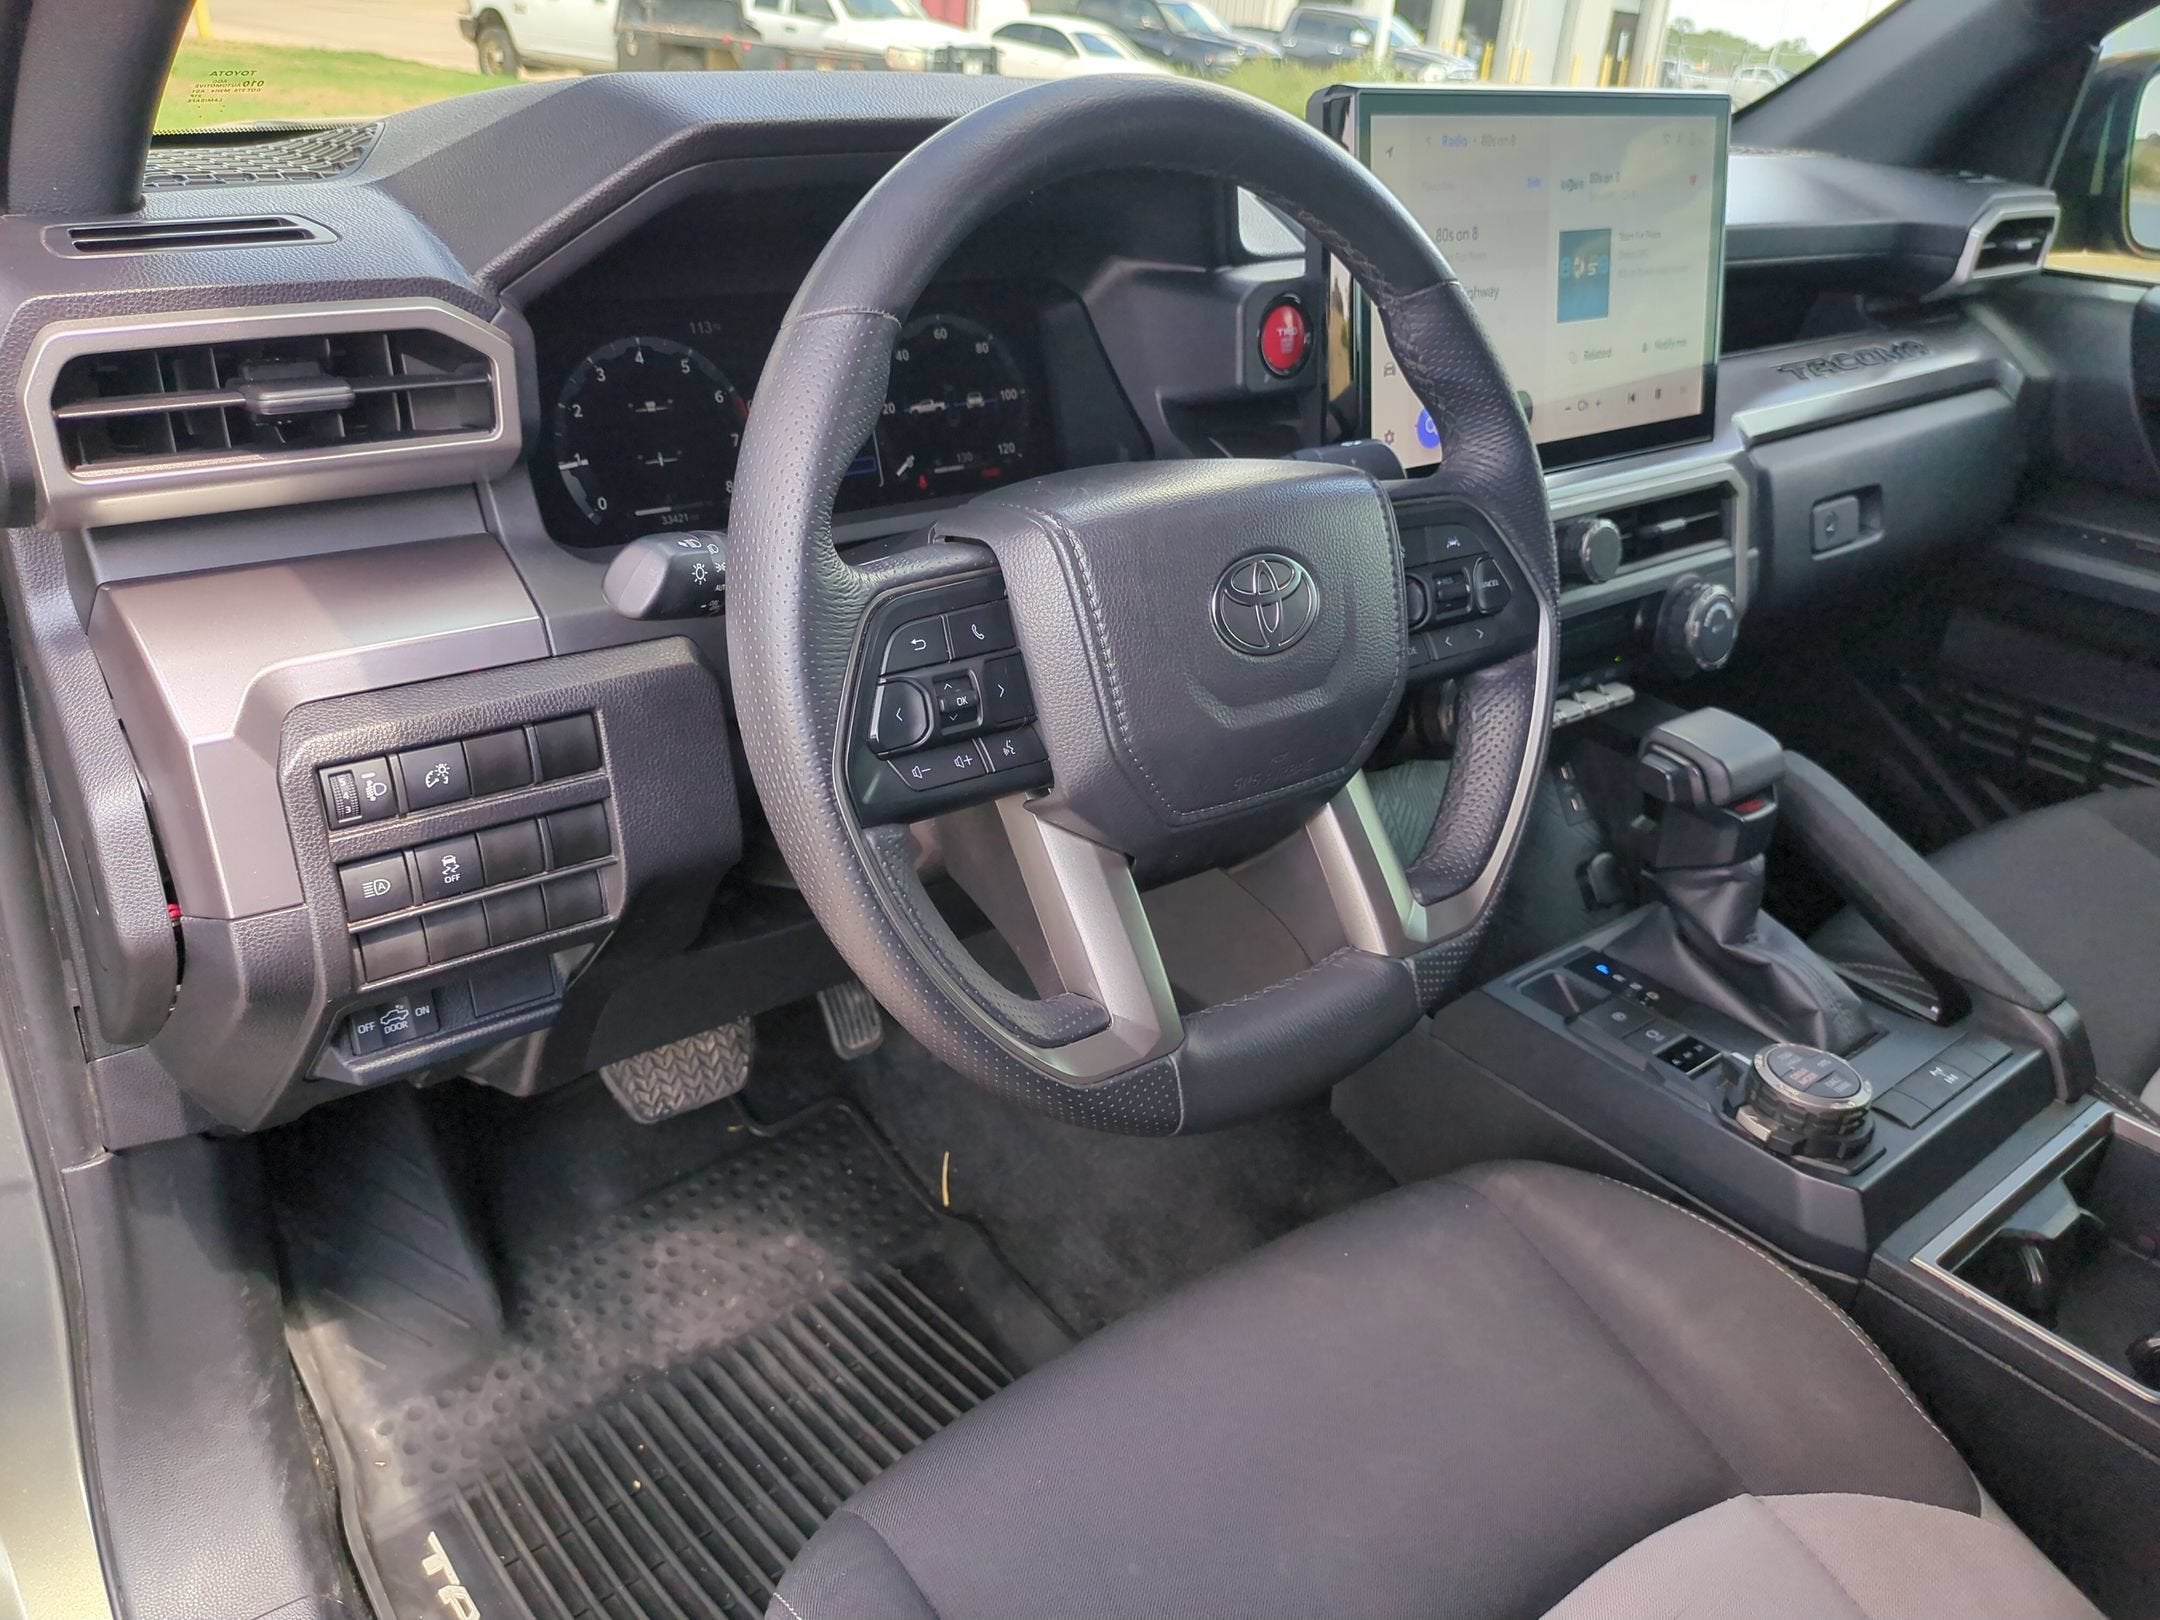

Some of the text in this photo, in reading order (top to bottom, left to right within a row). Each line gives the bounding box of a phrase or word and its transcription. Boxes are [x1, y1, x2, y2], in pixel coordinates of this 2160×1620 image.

[1435, 226, 1478, 242] 80s on 8
[933, 327, 948, 340] 60
[975, 342, 990, 354] 80
[634, 350, 644, 365] 4
[895, 349, 910, 362] 40
[1775, 339, 1931, 381] TACOMA
[680, 359, 690, 374] 5
[596, 368, 606, 382] 3
[714, 389, 724, 404] 6
[1000, 388, 1017, 401] 100
[572, 404, 583, 418] 2
[882, 402, 896, 415] 20
[730, 433, 739, 447] 7
[998, 442, 1015, 455] 120
[725, 481, 734, 493] 8
[597, 496, 608, 510] 0
[714, 583, 727, 592] AUT
[956, 696, 968, 707] OK
[343, 791, 350, 800] 4
[345, 805, 352, 814] 3
[444, 873, 461, 884] OFF
[414, 1005, 431, 1017] ON
[357, 1021, 376, 1035] OFF
[384, 1021, 409, 1035] DOOR
